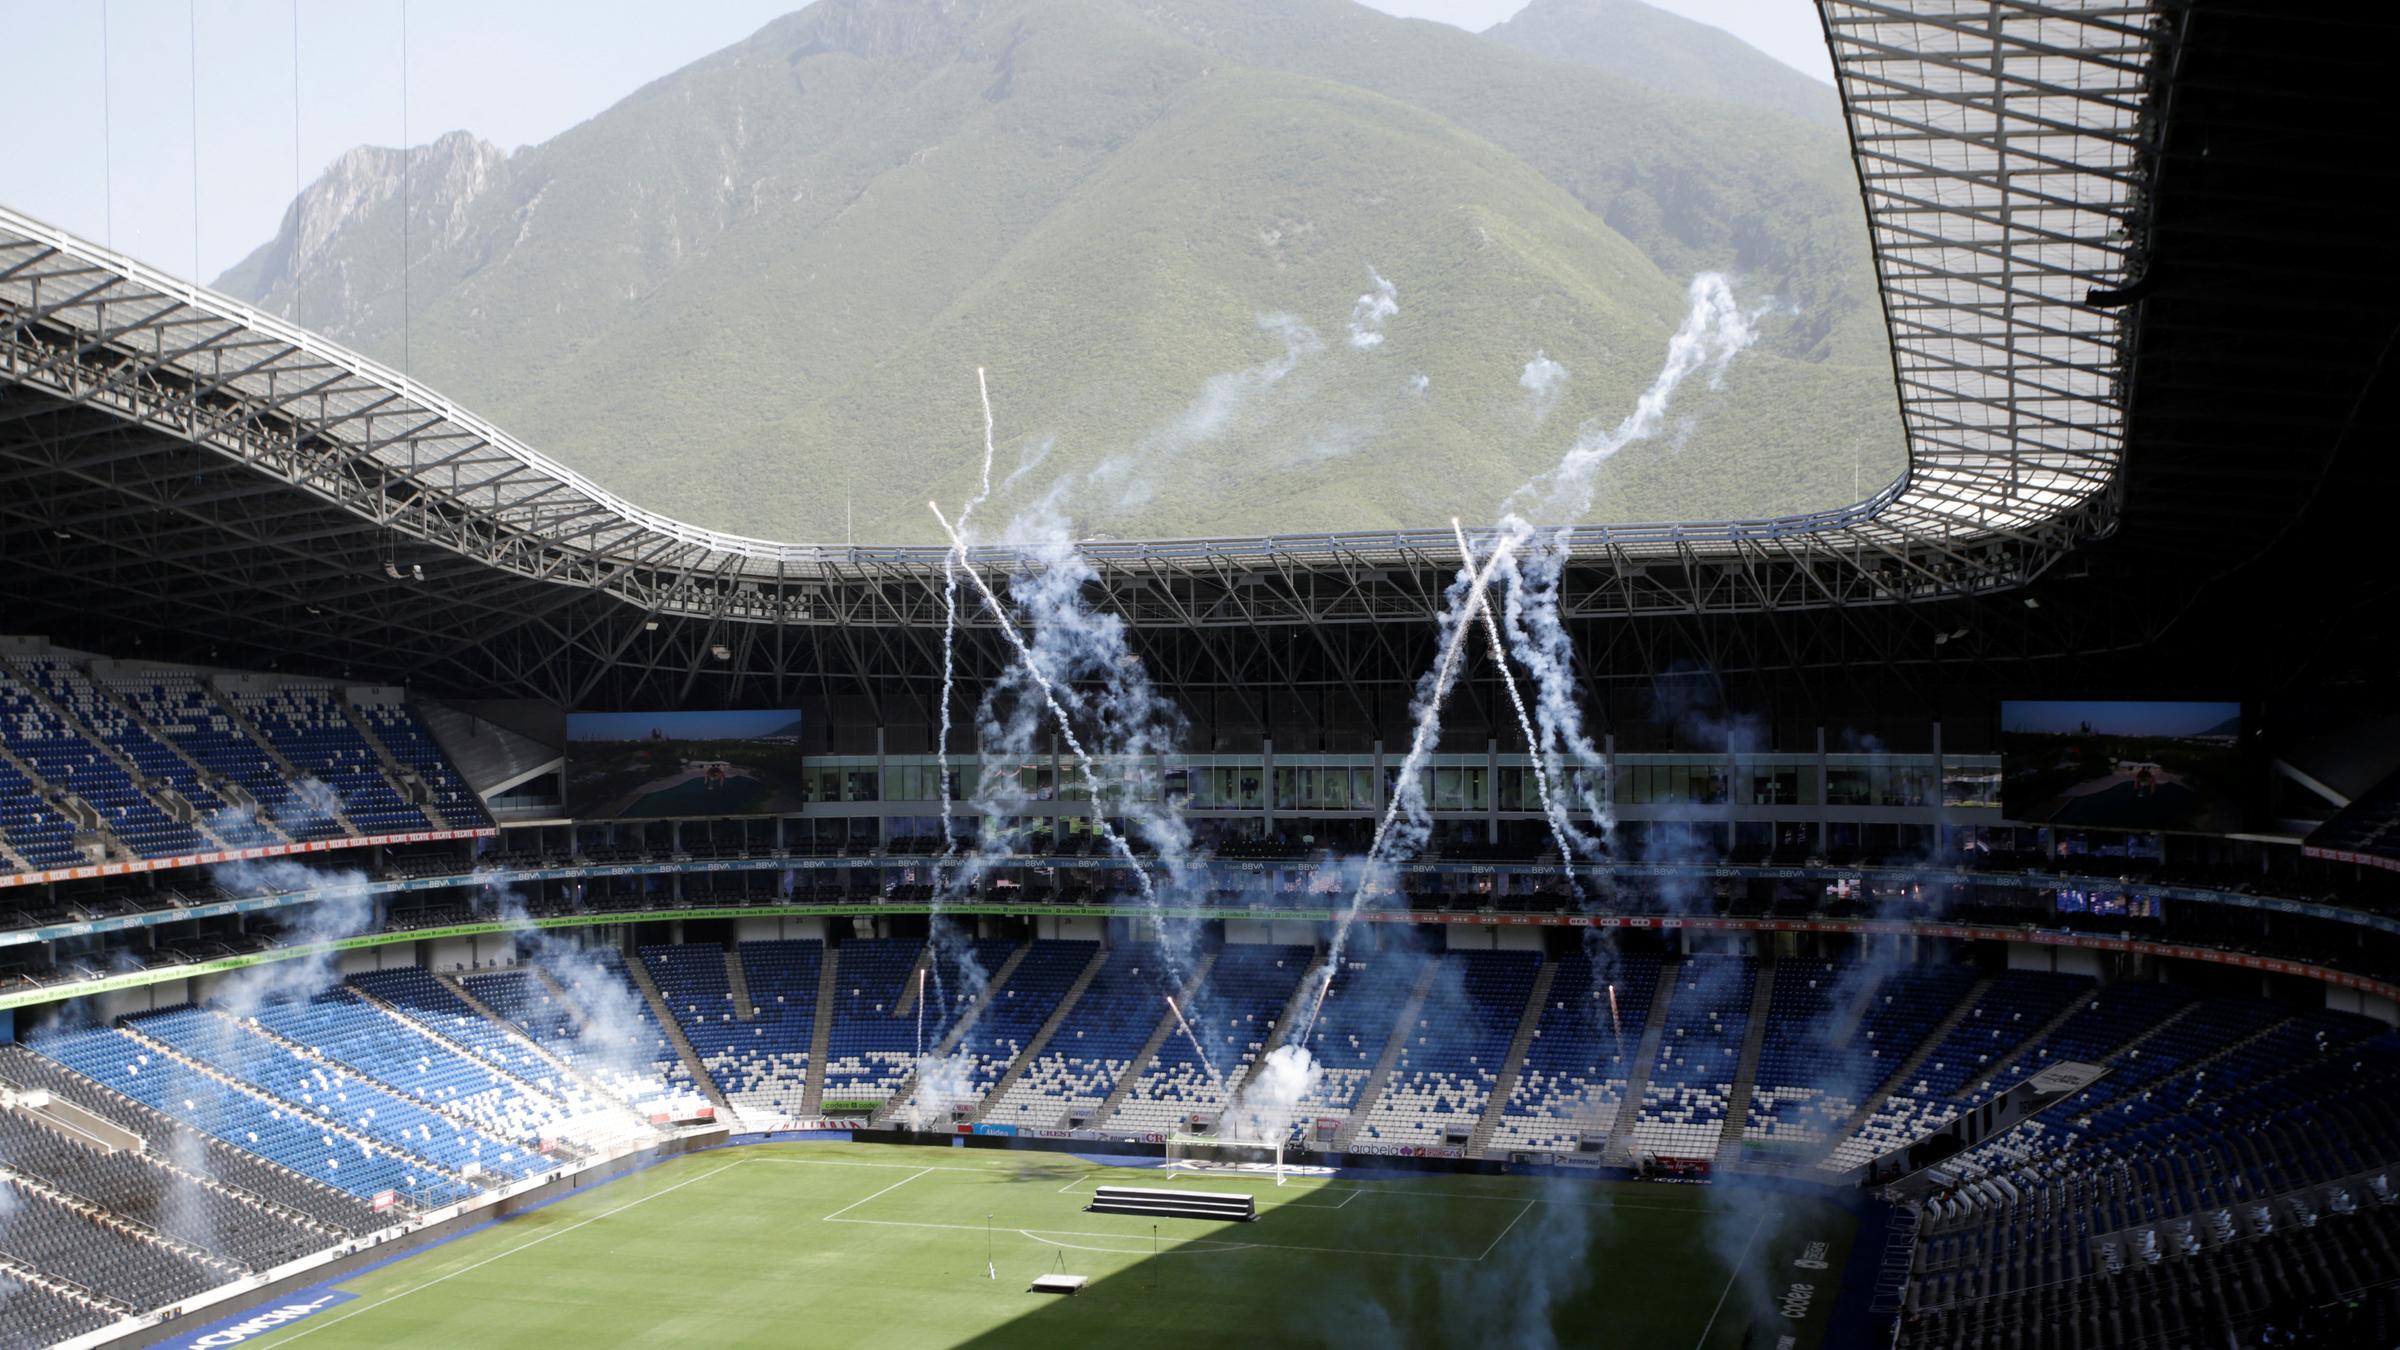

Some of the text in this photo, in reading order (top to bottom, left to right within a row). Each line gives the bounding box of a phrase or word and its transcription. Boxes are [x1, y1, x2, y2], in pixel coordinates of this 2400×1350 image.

[708, 863, 731, 871] BBVA
[756, 861, 778, 869] BBVA
[1025, 859, 1047, 867] BBVA
[1242, 862, 1264, 870] BBVA
[1298, 863, 1321, 871] BBVA
[565, 869, 587, 878] BBVA
[611, 867, 634, 876] BBVA
[660, 865, 682, 873] BBVA
[1532, 866, 1556, 874] BBVA
[1592, 867, 1616, 875] BBVA
[1653, 867, 1678, 876] BBVA
[1716, 868, 1741, 877] BBVA
[518, 872, 540, 881] BBVA
[1779, 870, 1805, 878] BBVA
[1838, 871, 1863, 879] BBVA
[1891, 872, 1917, 881] BBVA
[429, 880, 450, 888] BBVA
[1945, 875, 1970, 884] BBVA
[1997, 878, 2022, 887] BBVA
[2049, 881, 2072, 889] BBVA
[2148, 887, 2170, 896] BBVA
[2196, 892, 2219, 901] BBVA
[263, 898, 281, 908] BBVA
[219, 905, 238, 914] BBVA
[172, 911, 192, 920] BBVA
[123, 917, 144, 927] BBVA
[72, 925, 94, 935] BBVA
[16, 932, 40, 942] BBVA
[1040, 1130, 1073, 1138] CREST
[1351, 1142, 1399, 1156] arabela
[1776, 1283, 1816, 1319] codere
